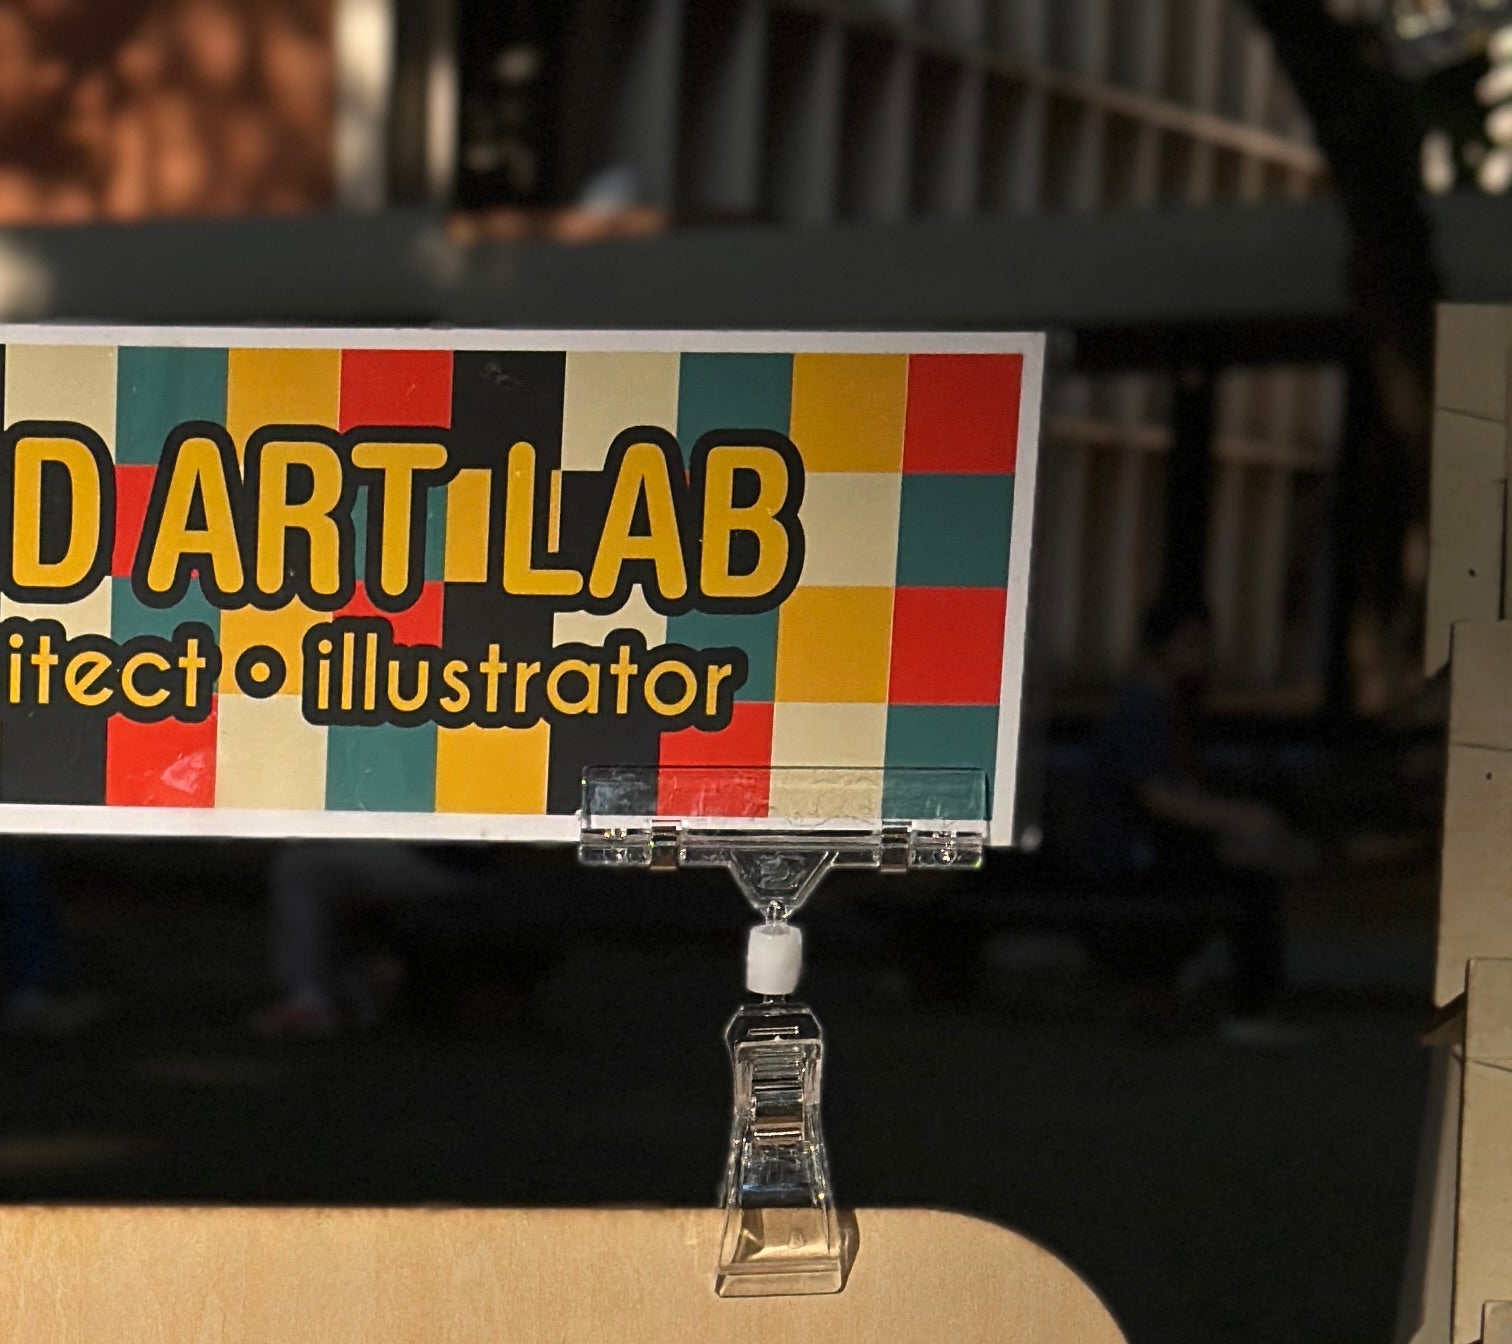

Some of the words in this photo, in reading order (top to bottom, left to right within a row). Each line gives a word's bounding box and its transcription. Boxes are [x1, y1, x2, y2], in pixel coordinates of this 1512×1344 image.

[147, 440, 448, 597] ART
[501, 442, 791, 600] LAB
[316, 636, 735, 720] illustrator
